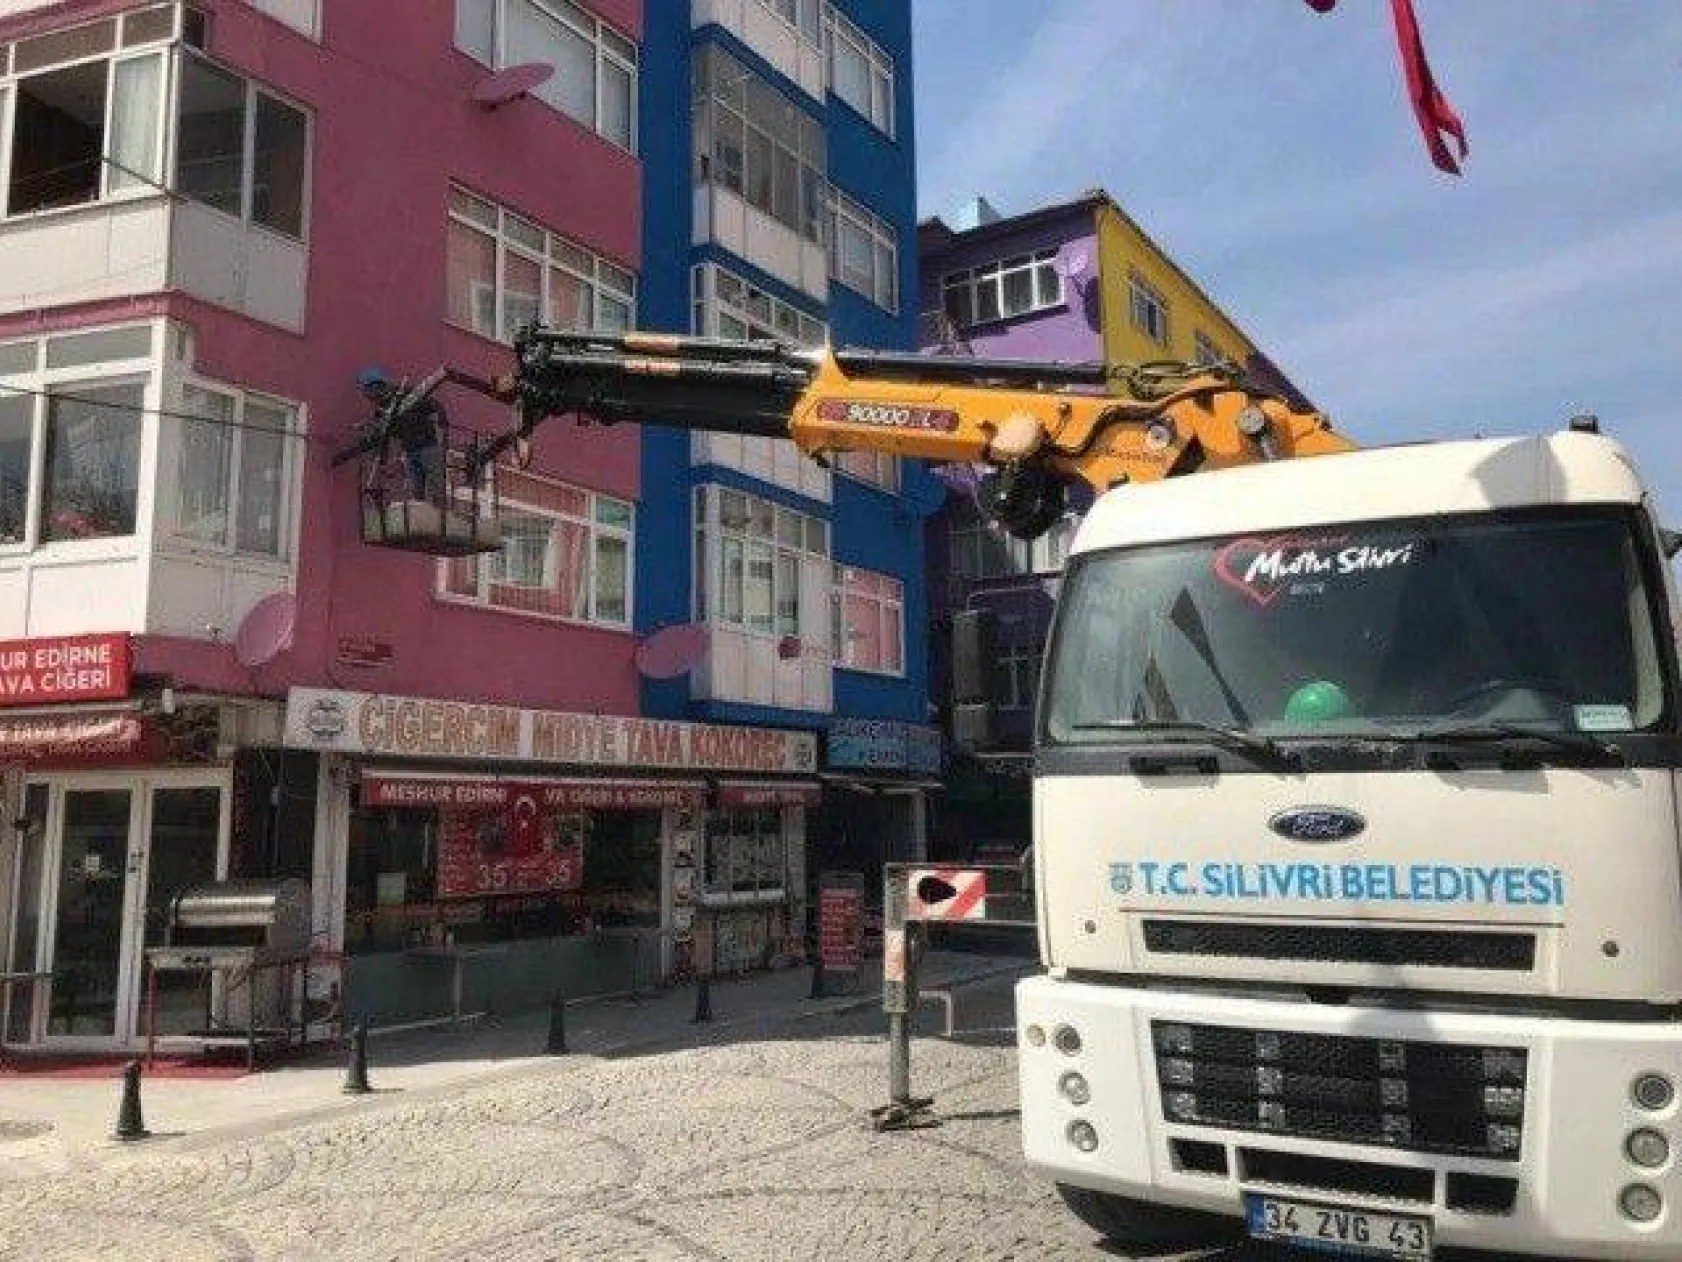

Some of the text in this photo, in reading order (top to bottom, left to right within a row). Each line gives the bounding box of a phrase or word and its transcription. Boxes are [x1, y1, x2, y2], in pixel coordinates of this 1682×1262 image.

[35, 642, 111, 669] EDİRNE
[1138, 861, 1198, 895] T.C.
[1202, 863, 1334, 898] SİLİVRİ
[1342, 864, 1565, 905] BELEDİYESİ
[1267, 1202, 1426, 1250] 34 ZVG 43
